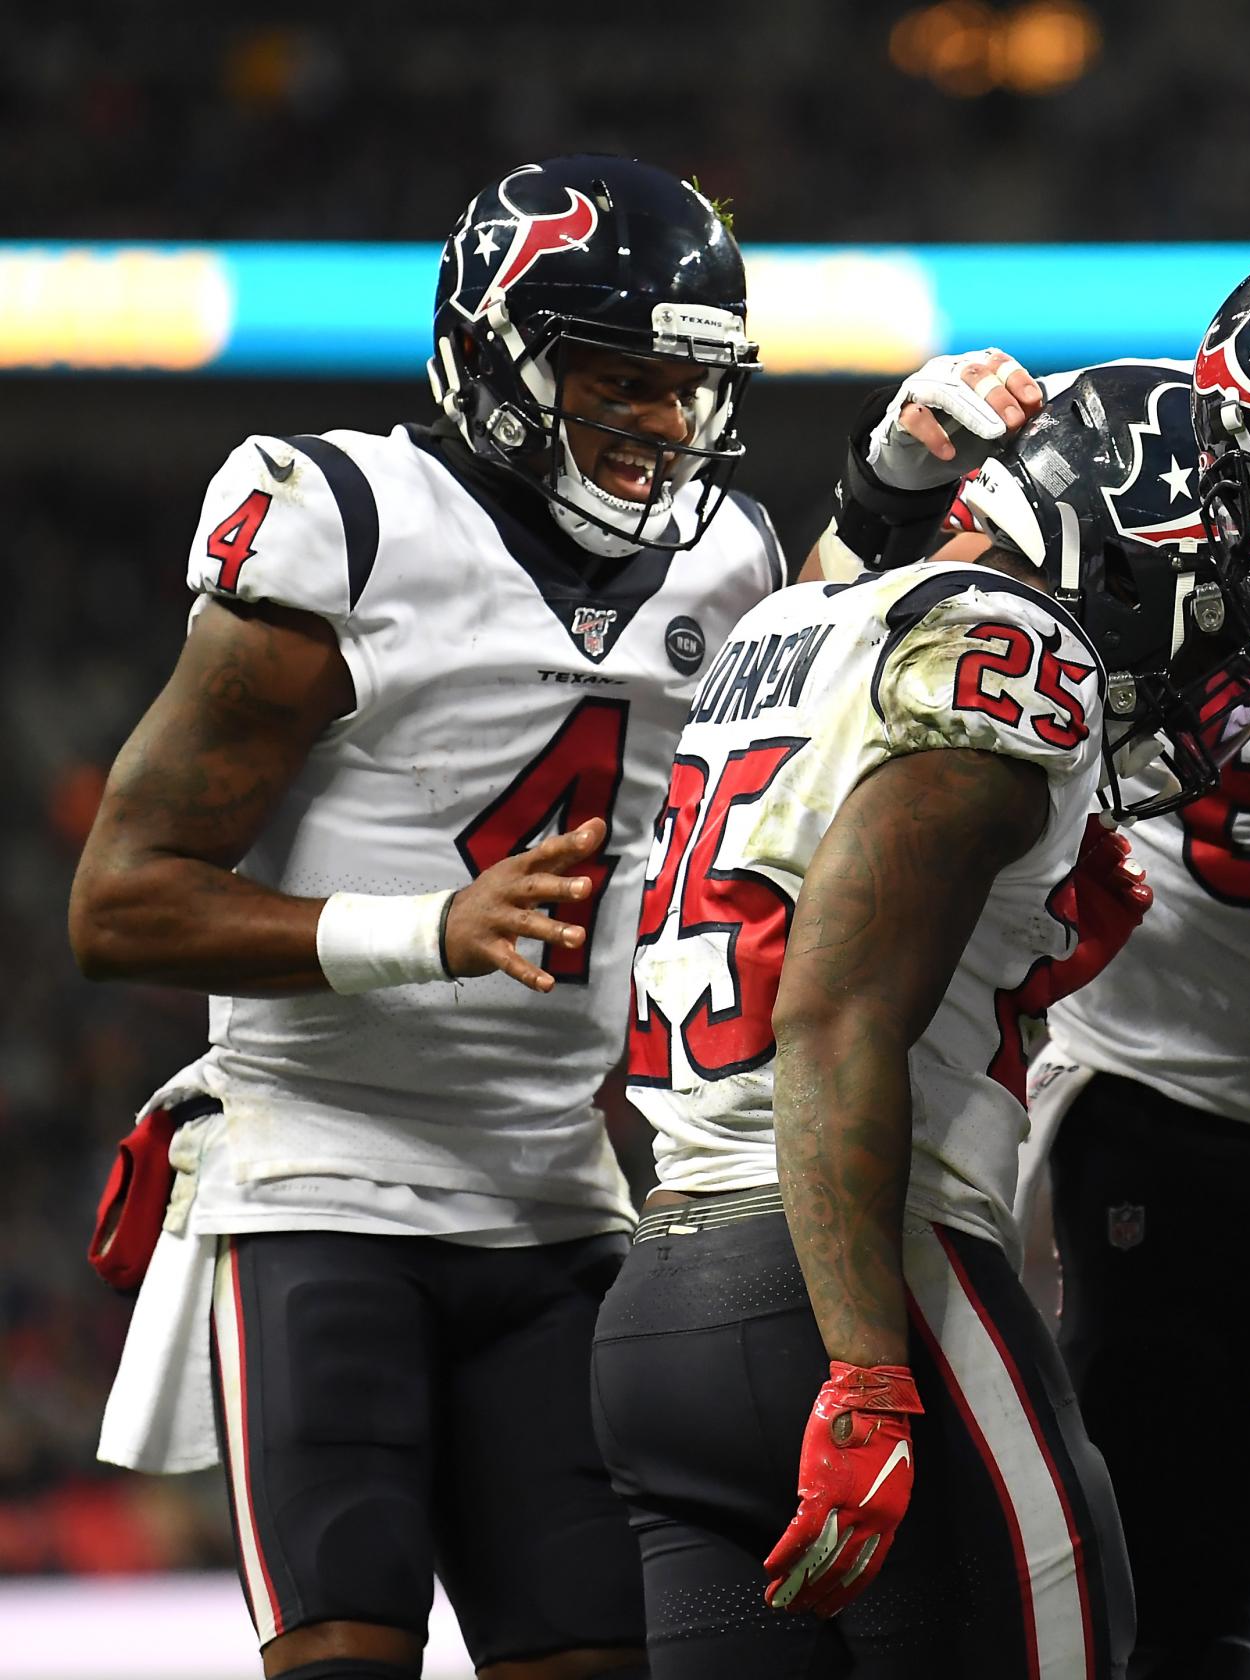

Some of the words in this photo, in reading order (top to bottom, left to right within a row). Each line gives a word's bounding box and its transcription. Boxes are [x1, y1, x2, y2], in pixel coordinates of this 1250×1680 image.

[680, 315, 722, 327] TEXANS
[206, 488, 273, 594] 4
[537, 670, 629, 685] TEXAN
[687, 624, 836, 724] JOHNSN
[952, 622, 1097, 750] 25
[453, 695, 631, 984] 4
[627, 737, 811, 1091] 25
